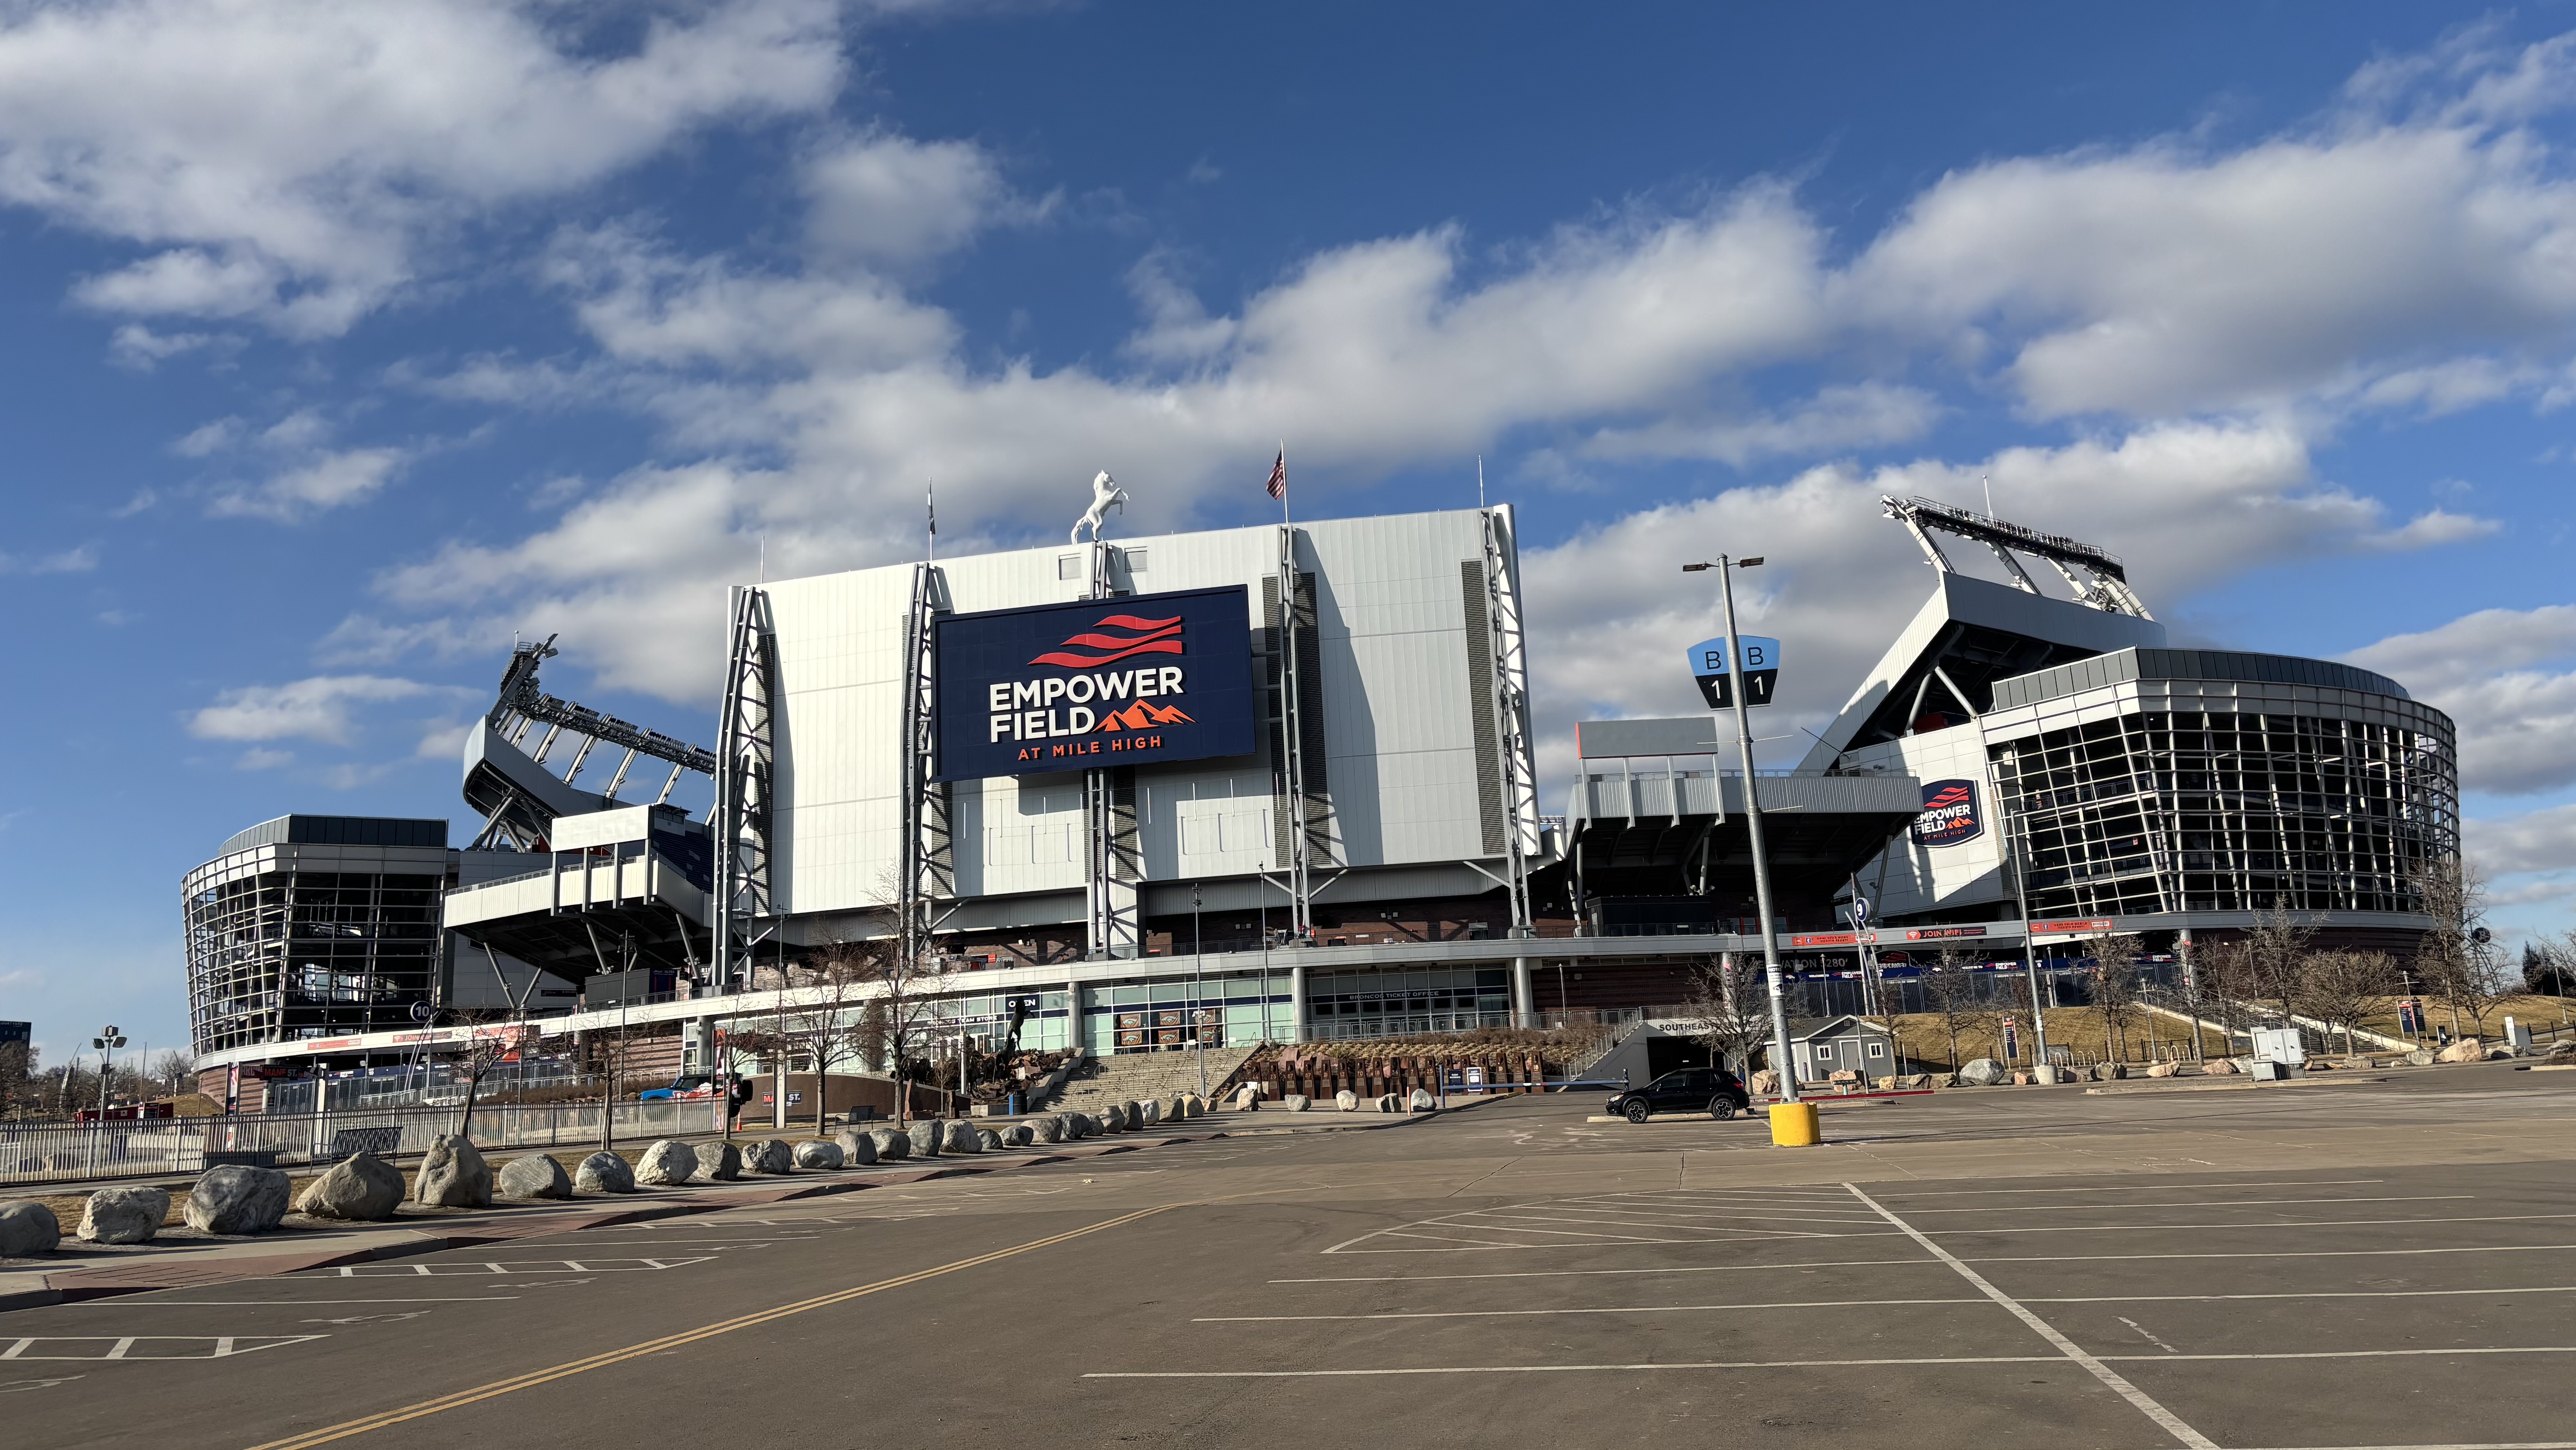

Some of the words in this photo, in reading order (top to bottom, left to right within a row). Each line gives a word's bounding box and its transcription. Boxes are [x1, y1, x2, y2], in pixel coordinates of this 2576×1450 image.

[1705, 651, 1722, 670] B
[1748, 647, 1764, 666] B
[990, 666, 1184, 712] EMPOWER
[1712, 680, 1720, 699] 1
[1754, 676, 1763, 695] 1
[990, 706, 1096, 743] FIELD
[1018, 747, 1041, 761] AT
[1053, 742, 1100, 757] MILE
[1111, 735, 1161, 751] HIGH
[1915, 820, 1946, 835] FIELD
[1857, 903, 1863, 916] 9
[415, 1006, 430, 1017] 10
[1008, 999, 1036, 1008] OEN
